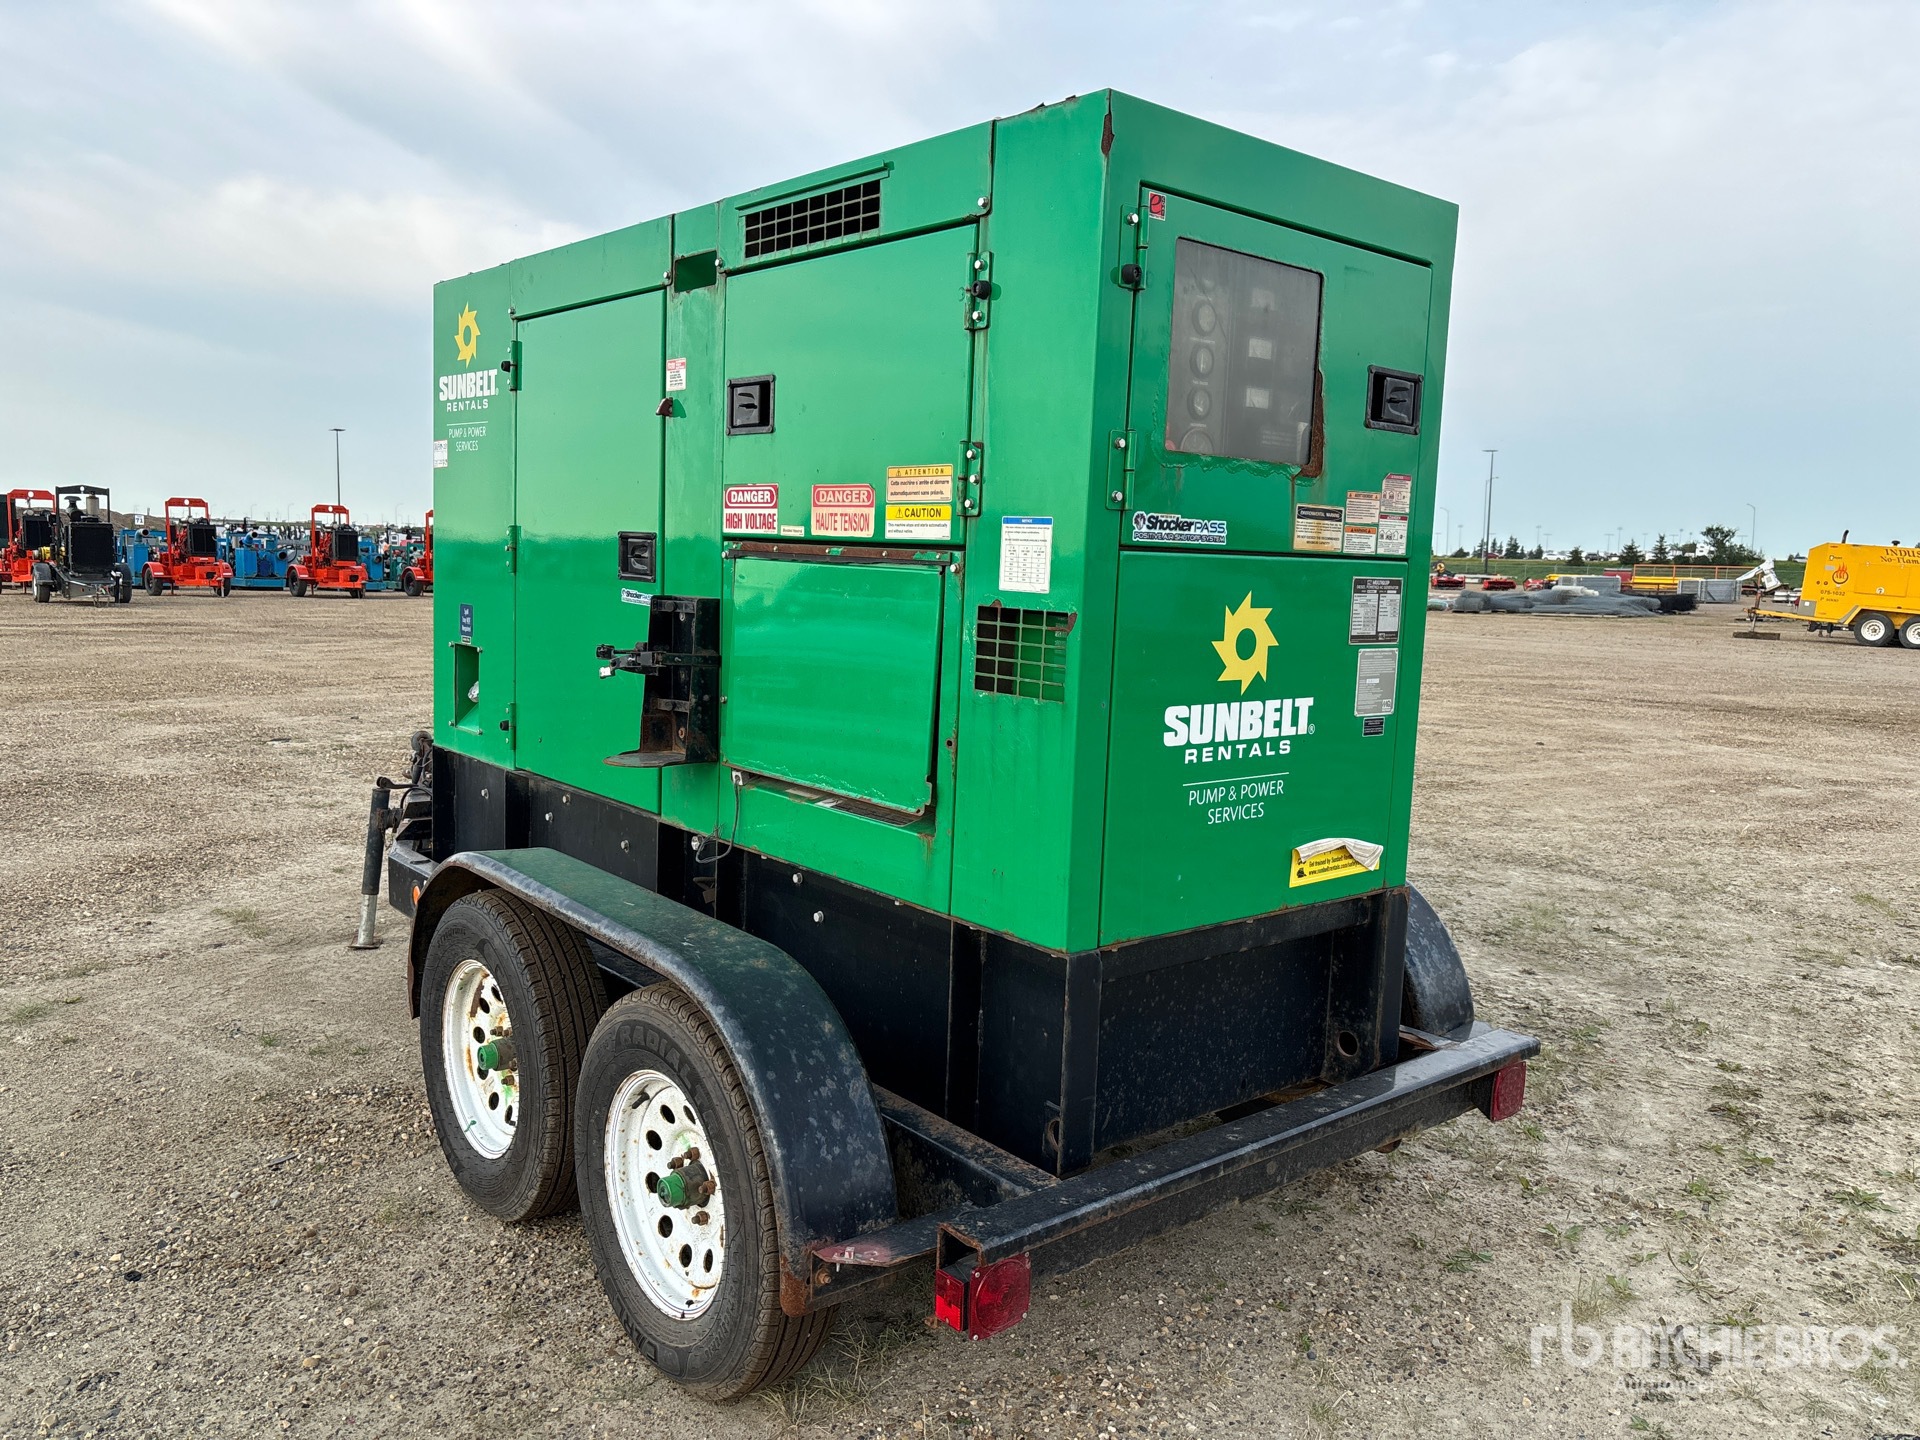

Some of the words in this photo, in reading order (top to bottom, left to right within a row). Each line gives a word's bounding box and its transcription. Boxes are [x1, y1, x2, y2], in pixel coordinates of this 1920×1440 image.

[439, 368, 498, 402] SUNBELT
[446, 399, 488, 412] RENTALS
[448, 428, 462, 438] PUMP
[468, 426, 486, 438] POWER
[456, 440, 478, 452] SERVICES
[731, 490, 770, 503] DANGER
[819, 488, 868, 502] DANGER
[725, 512, 744, 530] HIGH
[744, 512, 776, 530] VOLTAGE
[904, 508, 942, 518] CAUTION
[816, 512, 839, 532] HAUTE
[840, 512, 870, 532] TENSION
[1134, 532, 1162, 540] POSITIVE
[1163, 696, 1314, 746] SUNBELT
[1184, 740, 1291, 764] RENTALS
[1188, 786, 1226, 806] PUMP
[1228, 788, 1237, 800] &
[1240, 780, 1284, 800] POWER
[1208, 802, 1264, 824] SERVICES
